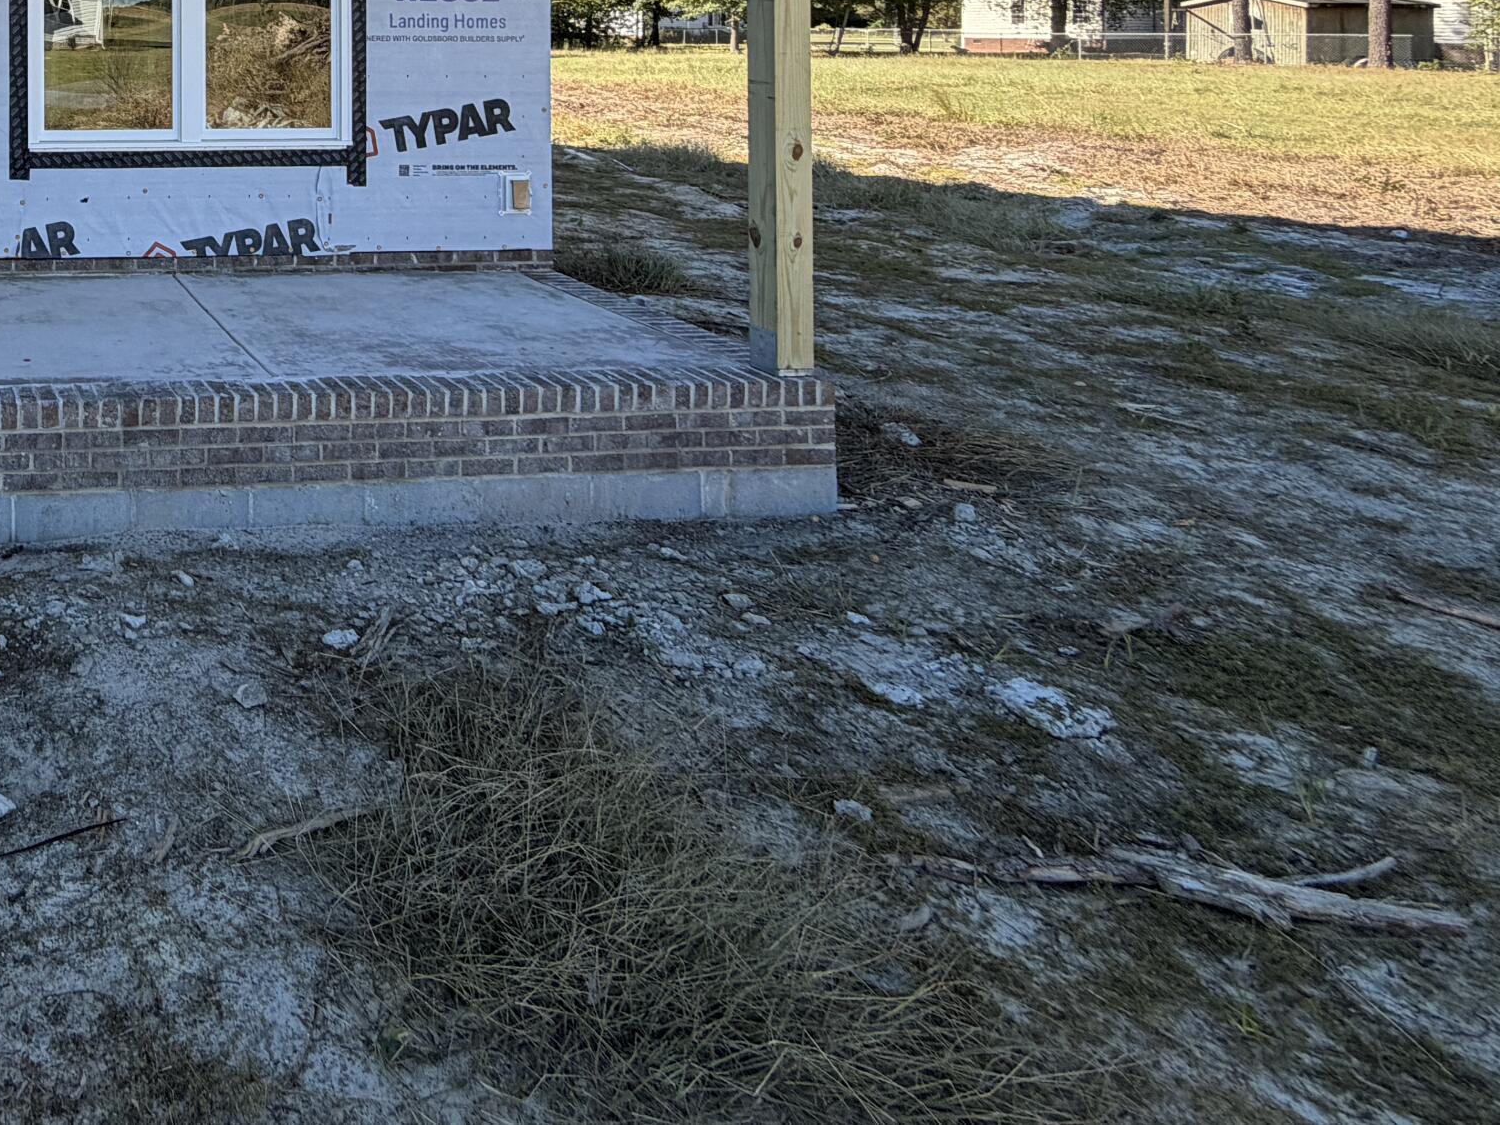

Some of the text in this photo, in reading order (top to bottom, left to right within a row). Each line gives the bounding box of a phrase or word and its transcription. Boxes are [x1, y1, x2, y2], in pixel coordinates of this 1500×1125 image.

[389, 13, 507, 32] Landing Homes
[378, 98, 517, 152] TYPAR
[16, 221, 81, 258] AR
